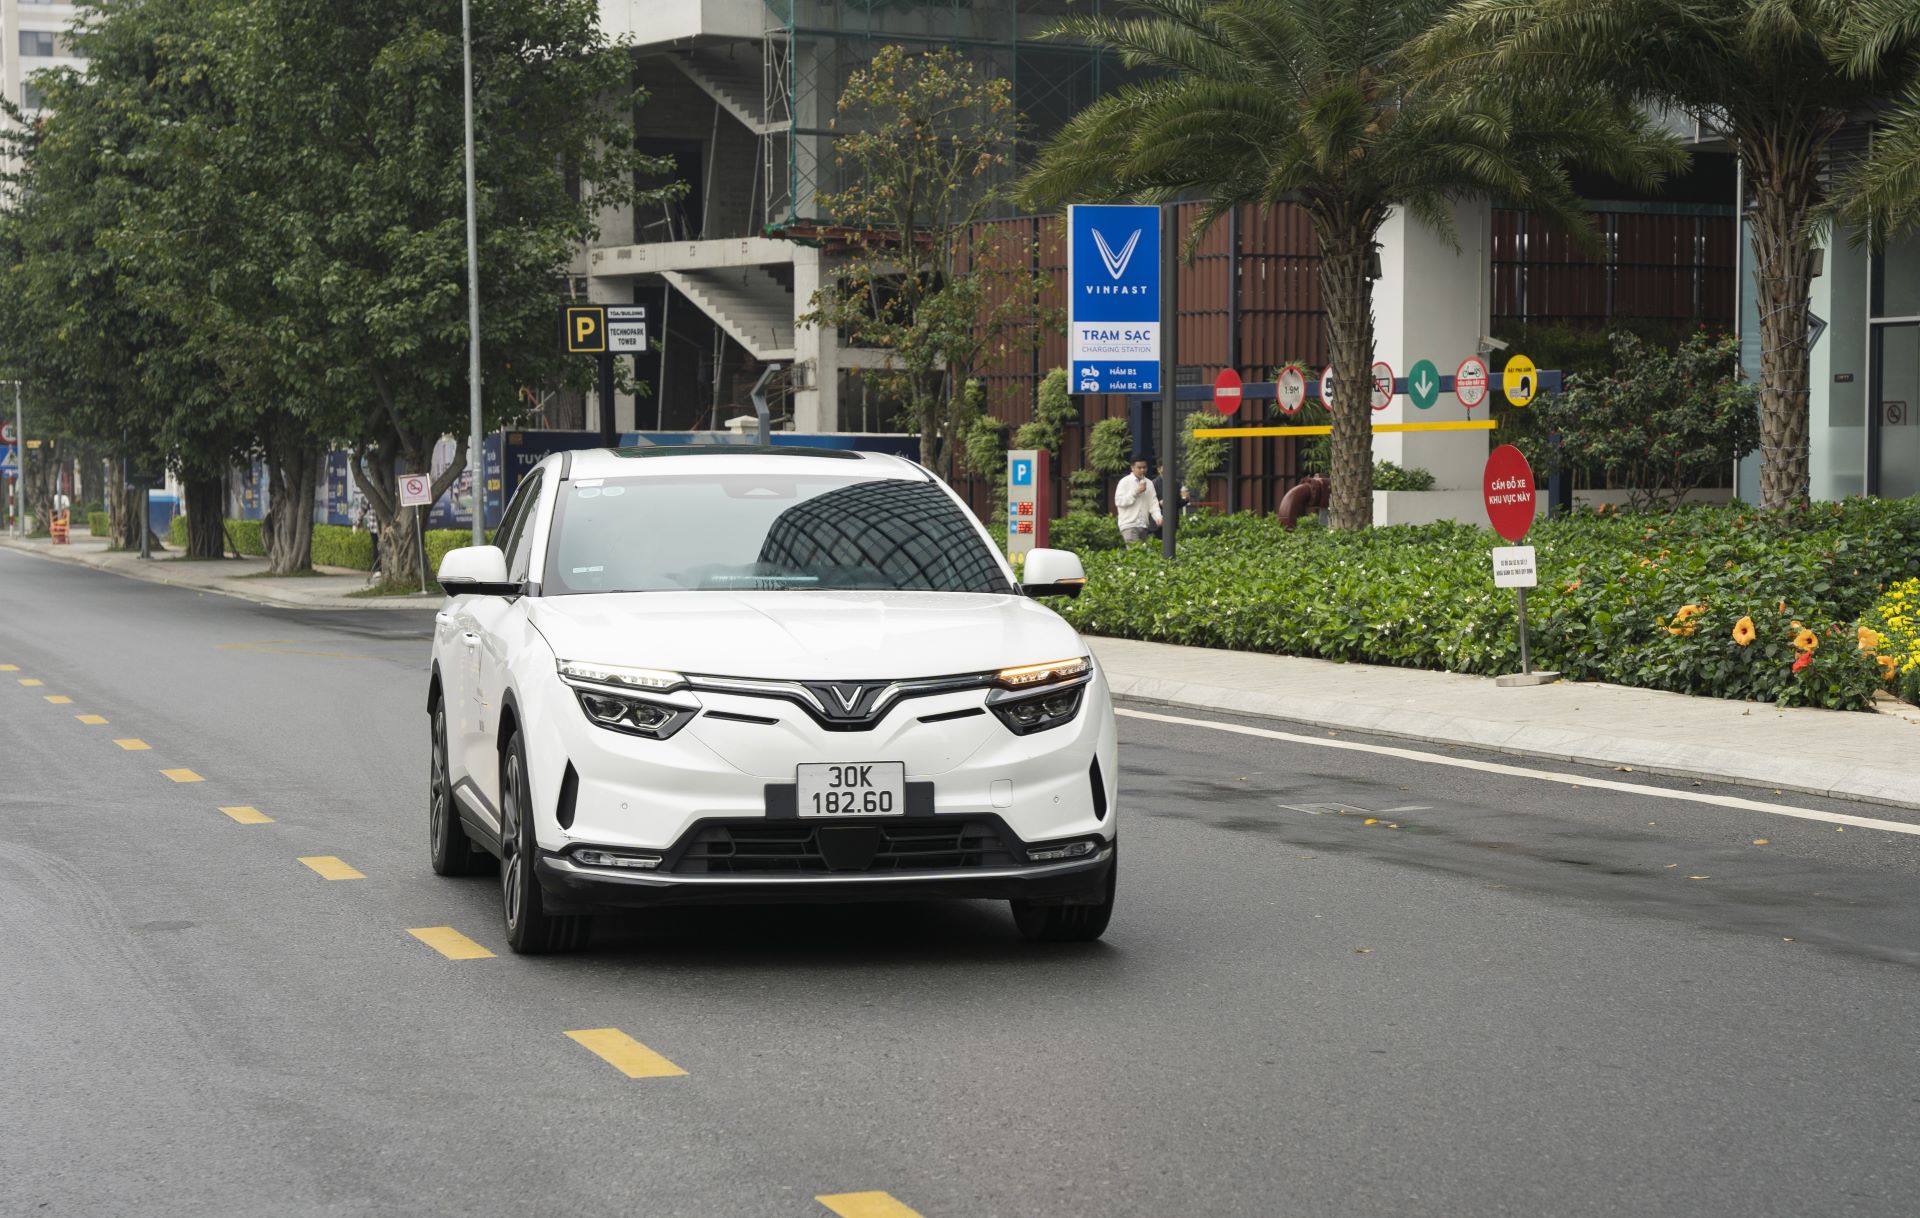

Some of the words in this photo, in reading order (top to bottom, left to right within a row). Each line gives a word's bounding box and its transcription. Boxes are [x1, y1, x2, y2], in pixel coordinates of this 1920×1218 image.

[1086, 285, 1147, 295] VINFAST
[576, 316, 596, 343] P
[610, 328, 644, 337] TECHNOPARK
[618, 338, 637, 346] TOWER
[1082, 330, 1120, 344] TRẠM
[1124, 330, 1151, 344] SẠC
[1127, 368, 1137, 376] B1
[1127, 382, 1137, 390] B2
[1142, 382, 1153, 390] B3
[1284, 386, 1300, 395] 1.9M
[1017, 463, 1027, 482] P
[1491, 478, 1506, 491] CẤM
[1517, 479, 1526, 489] XE
[1489, 495, 1502, 505] KHU
[1502, 493, 1517, 506] VỰC
[1517, 491, 1531, 503] NÀY
[828, 765, 873, 788] 30K
[812, 790, 893, 814] 182.60
